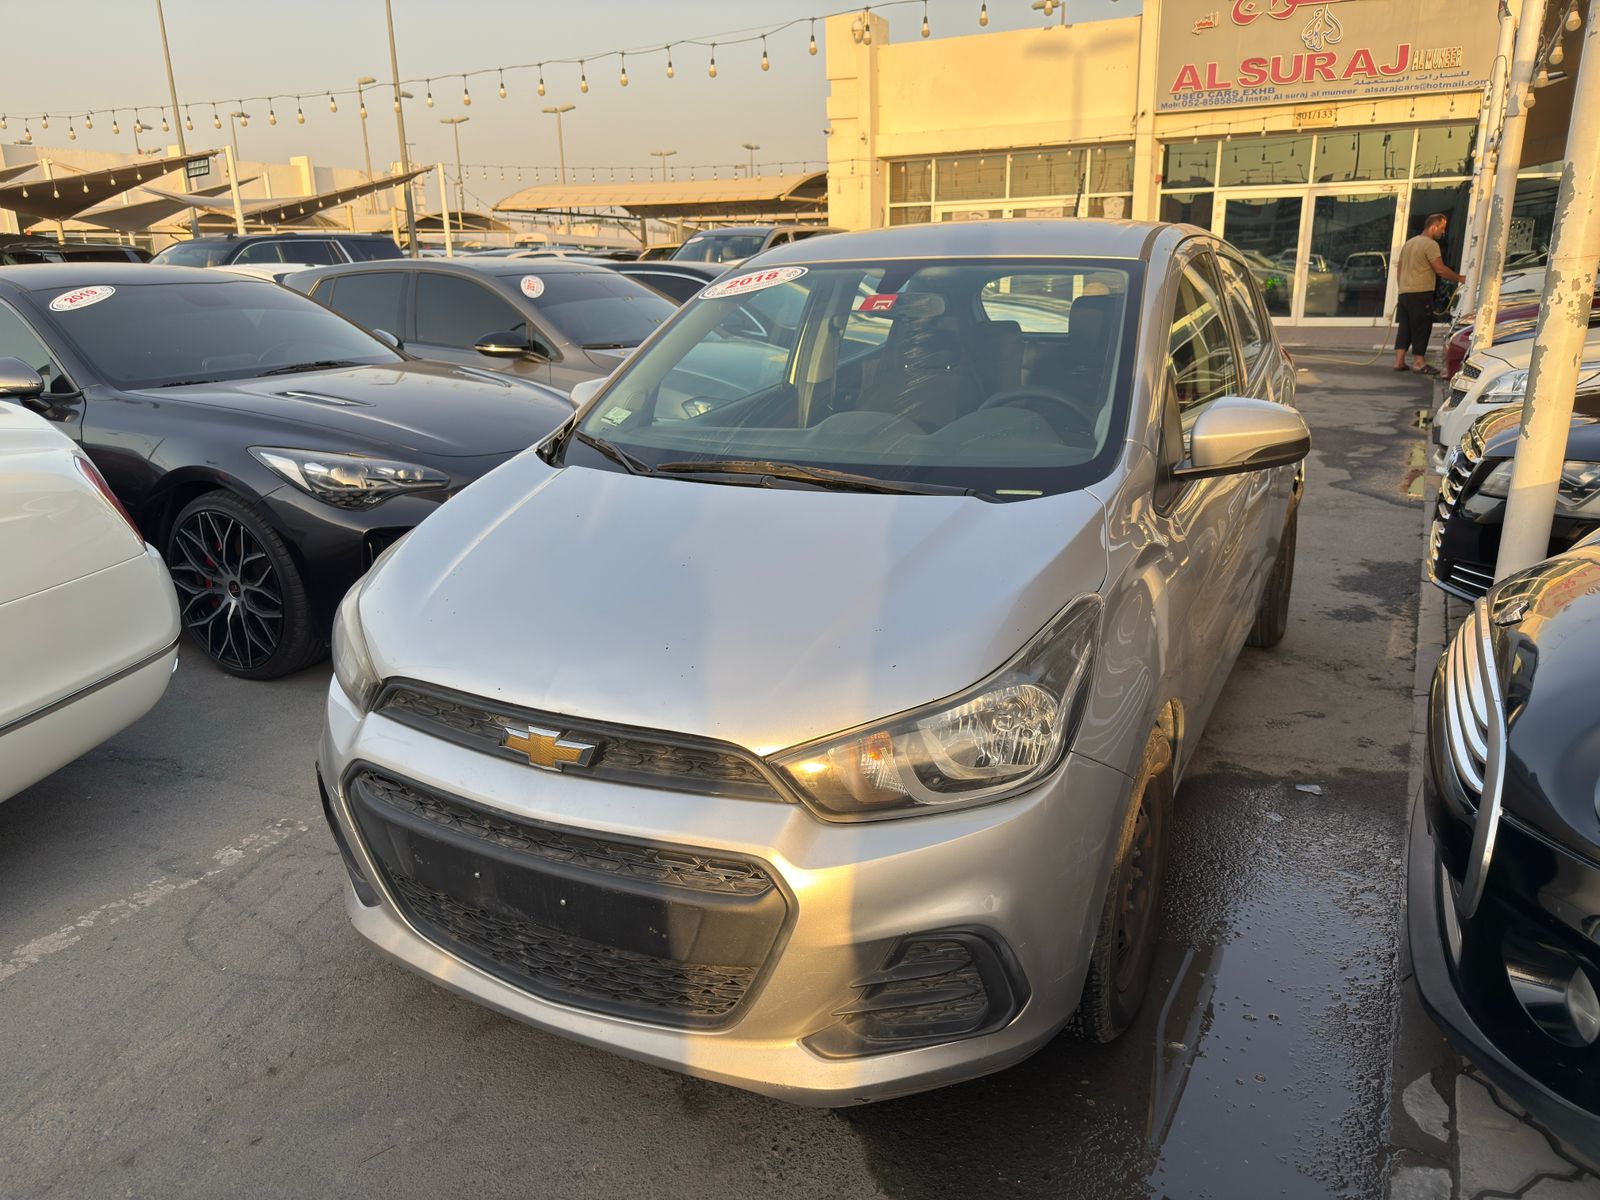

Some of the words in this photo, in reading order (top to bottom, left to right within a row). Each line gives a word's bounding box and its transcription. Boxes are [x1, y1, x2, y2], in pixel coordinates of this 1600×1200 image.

[1170, 63, 1232, 94] AL
[1239, 43, 1411, 87] SURAJ
[1411, 49, 1425, 71] AL
[1160, 102, 1180, 110] Mob:
[1181, 96, 1244, 107] 052-8585854
[1285, 91, 1308, 99] suraj
[1321, 88, 1357, 97] muneer
[1173, 93, 1204, 101] USED
[1207, 89, 1239, 98] CARS
[1242, 86, 1276, 96] EXHB
[725, 271, 780, 290] 2018
